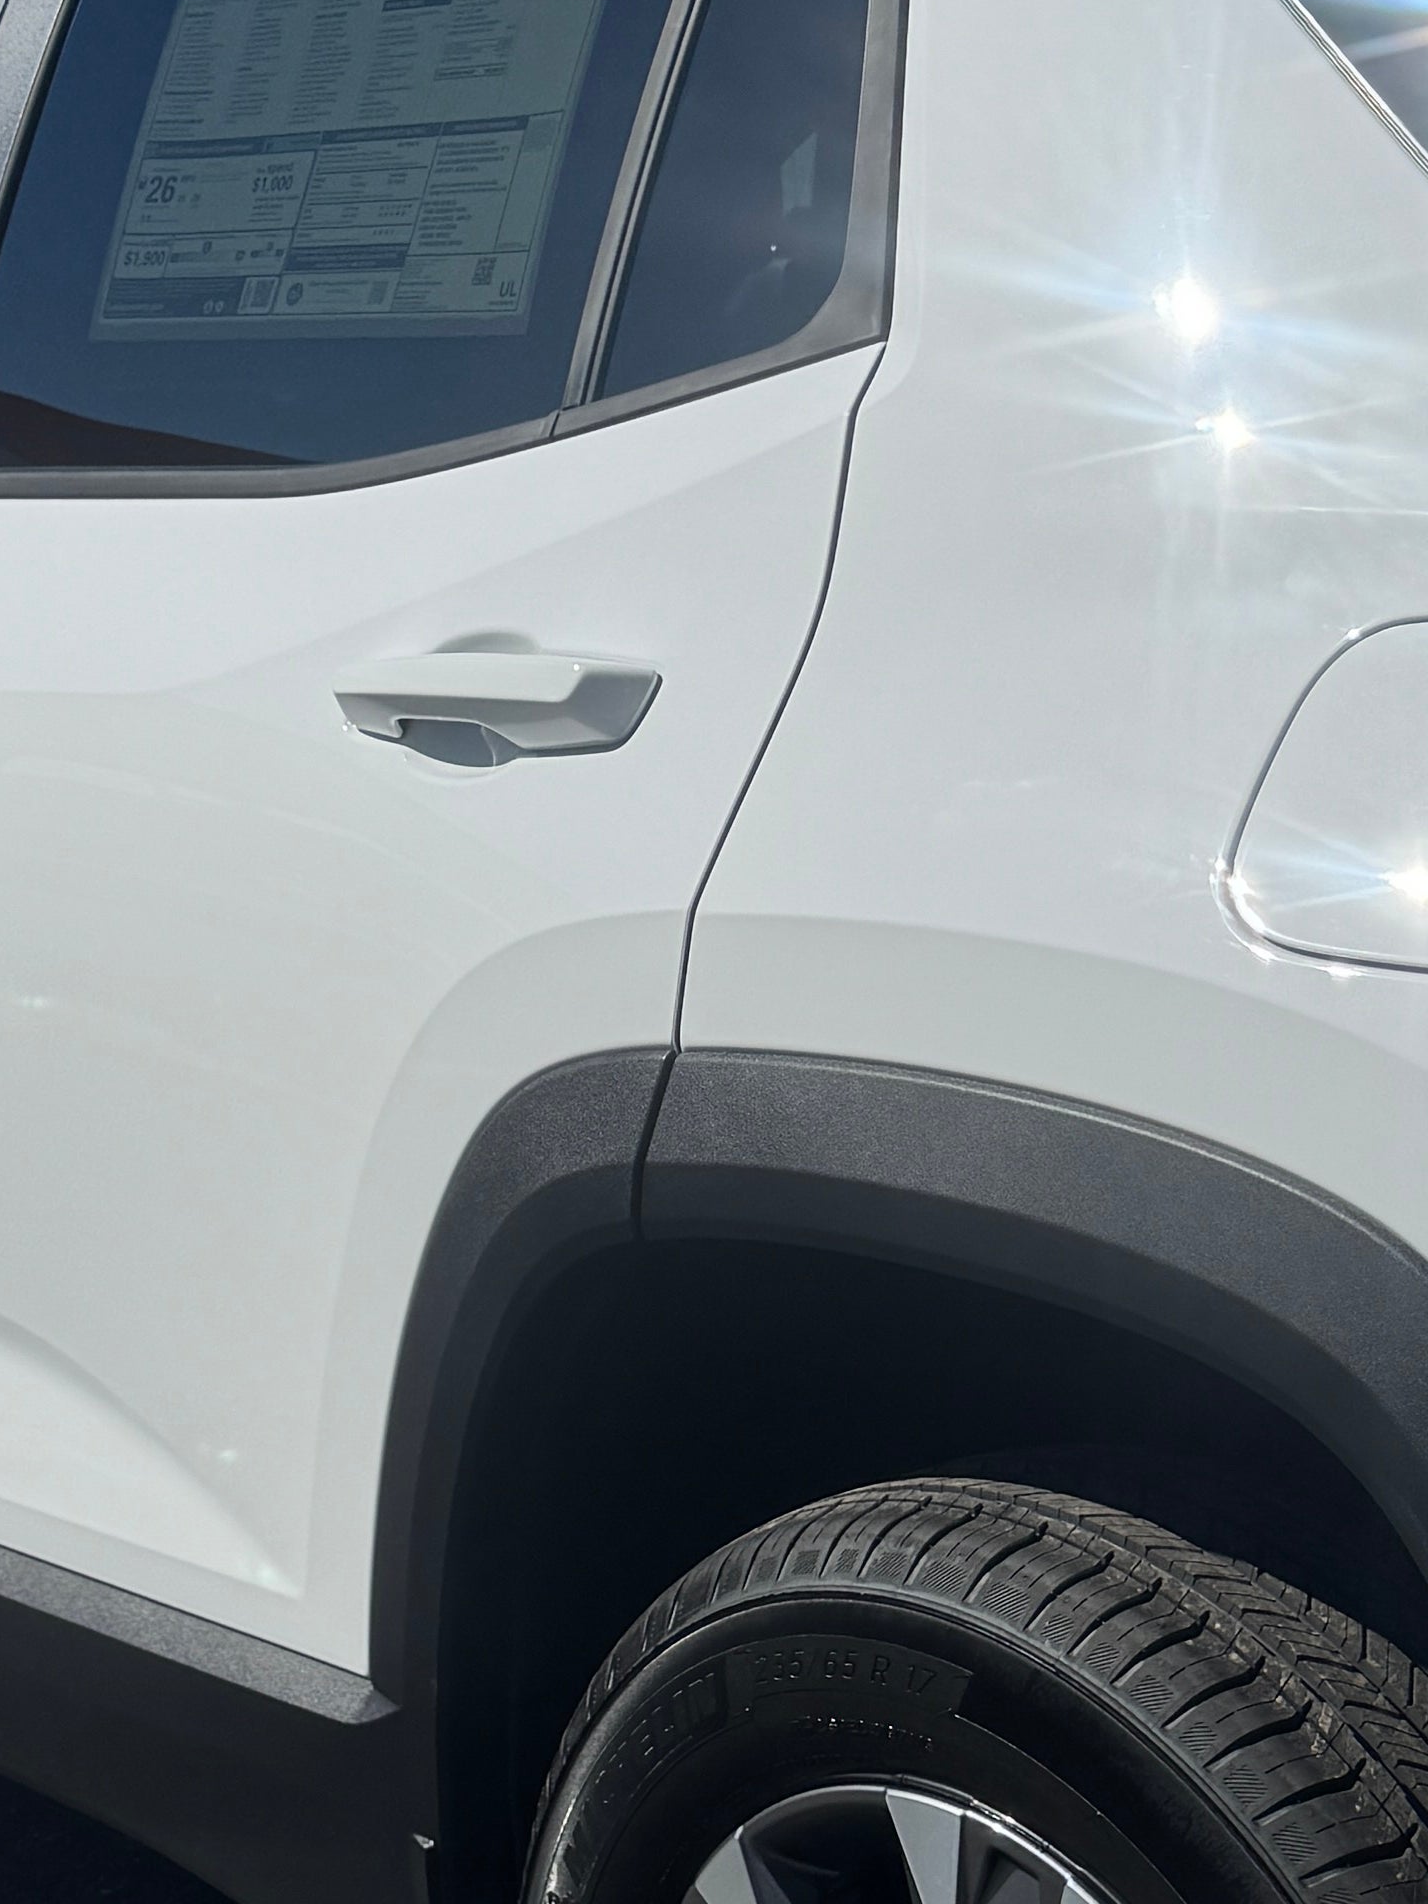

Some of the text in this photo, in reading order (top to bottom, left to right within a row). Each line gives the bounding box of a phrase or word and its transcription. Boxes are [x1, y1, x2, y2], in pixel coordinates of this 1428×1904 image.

[145, 175, 178, 204] 26
[251, 174, 294, 194] $1,000
[498, 280, 517, 298] UL
[753, 1649, 939, 1697] 235/65 R 17
